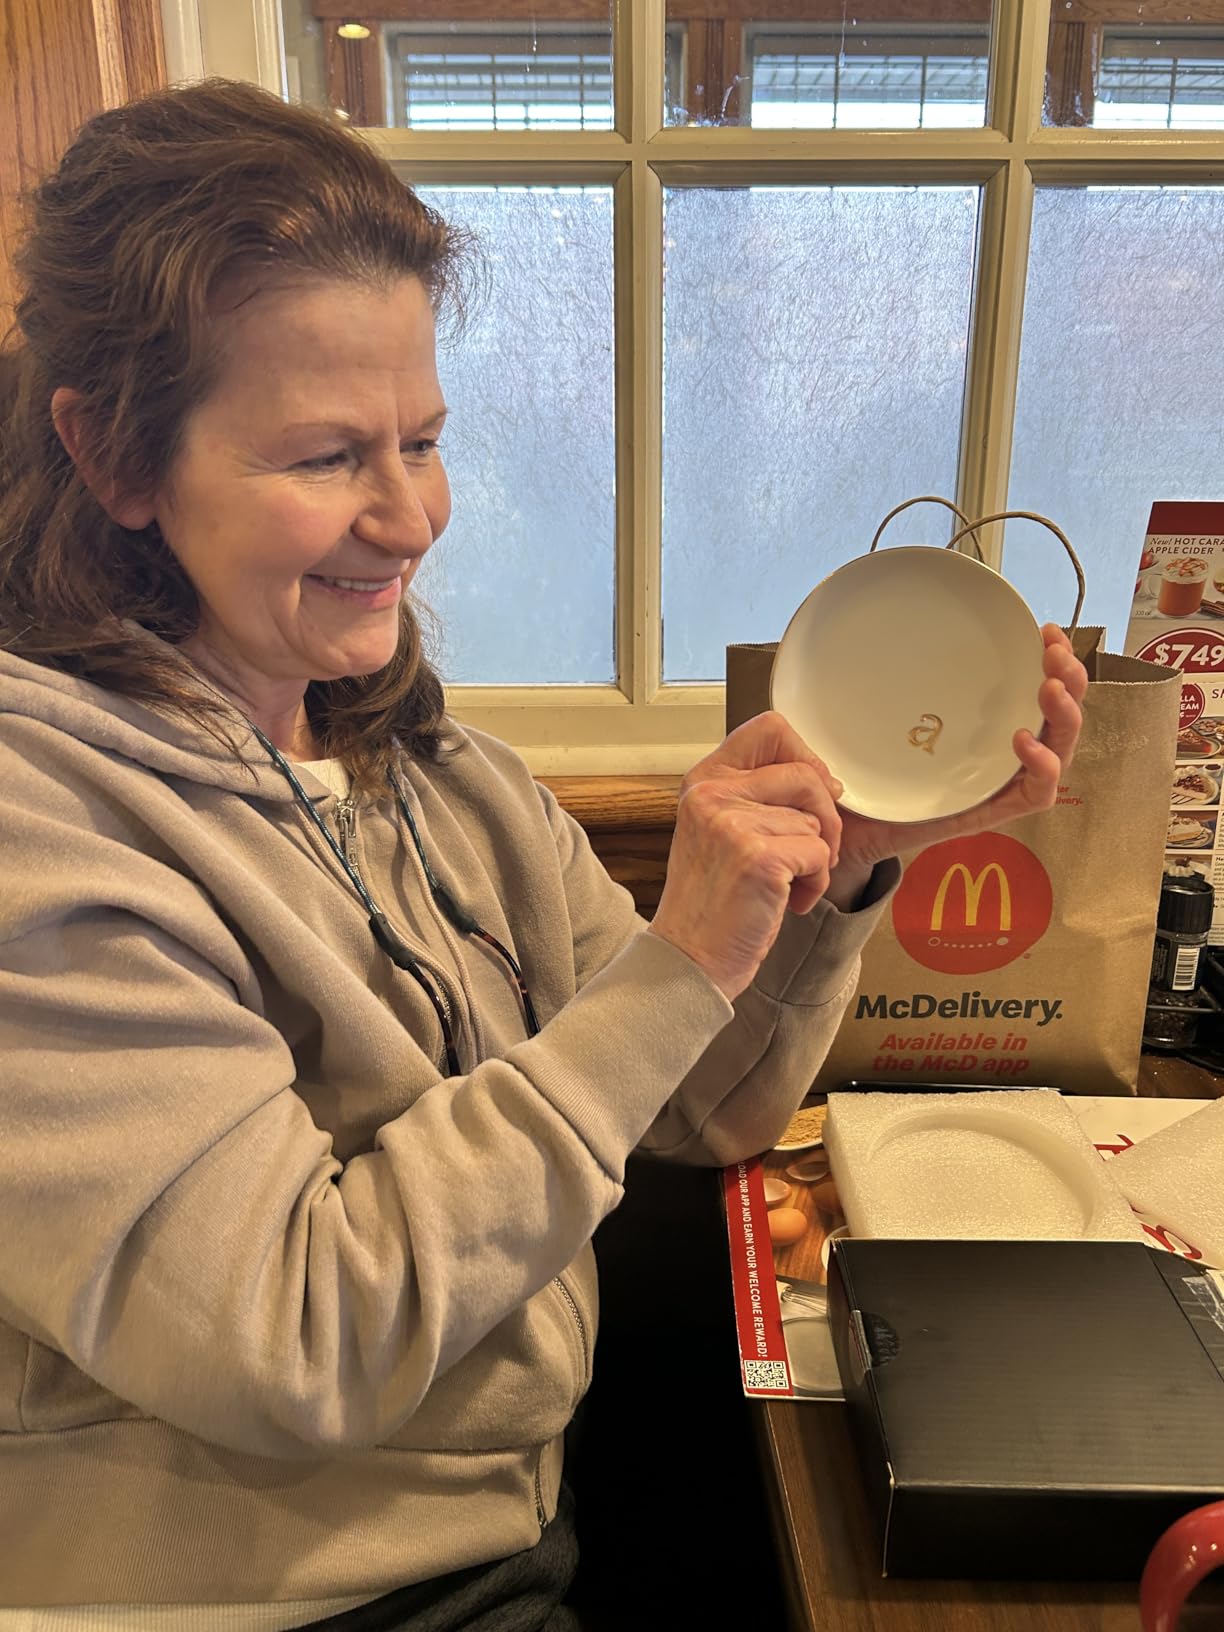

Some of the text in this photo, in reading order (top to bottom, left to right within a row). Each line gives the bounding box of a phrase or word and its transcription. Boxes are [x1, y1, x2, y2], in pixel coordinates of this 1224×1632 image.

[1147, 546, 1214, 555] APPLE CIDER
[1150, 537, 1173, 545] New!
[1174, 537, 1197, 545] HOT
[855, 991, 1063, 1027] McDelivery.
[879, 1032, 1029, 1051] Available in
[872, 1054, 1031, 1077] the McD app
[739, 1179, 749, 1193] OUR
[740, 1194, 751, 1207] APP
[742, 1207, 753, 1223] AND
[743, 1223, 755, 1244] EARN
[745, 1245, 757, 1269] YOUR
[748, 1270, 763, 1316] WELCOME
[753, 1316, 768, 1358] REWARD!
